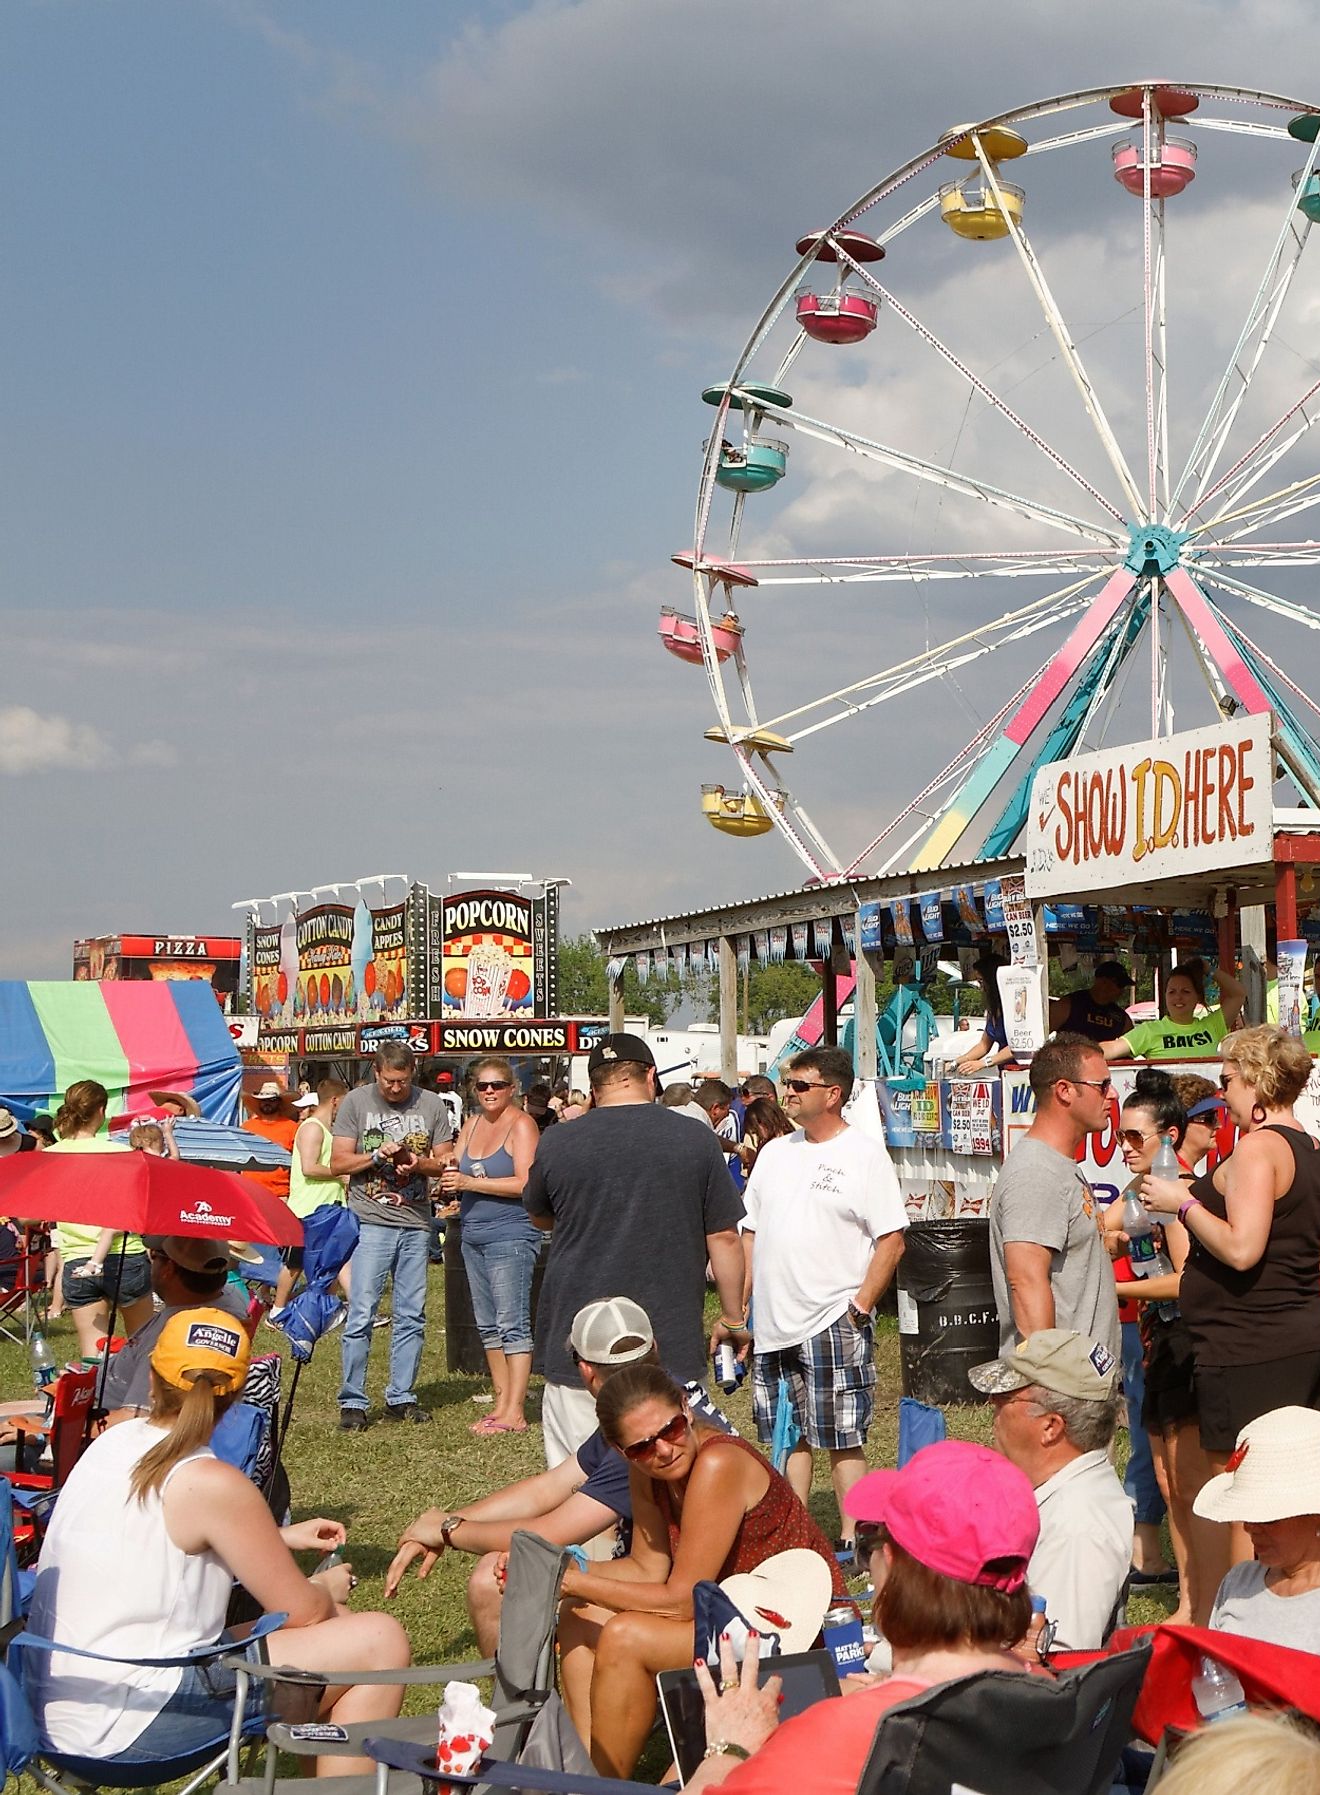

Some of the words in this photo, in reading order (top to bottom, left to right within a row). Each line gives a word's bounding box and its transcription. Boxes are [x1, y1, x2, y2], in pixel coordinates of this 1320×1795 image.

[1055, 764, 1126, 865] SHOW
[1132, 758, 1180, 862] I.D.
[1184, 739, 1255, 848] HERE
[374, 913, 403, 932] CANDY
[445, 899, 529, 935] POPCORN
[1005, 912, 1018, 921] CAN
[1018, 910, 1032, 920] BEER
[297, 914, 328, 948] COTTON
[328, 914, 353, 942] CANDY
[1008, 922, 1033, 938] $2.50
[155, 941, 207, 955] PIZZA
[256, 932, 280, 949] SNOW
[374, 932, 404, 949] APPLES
[256, 949, 280, 965] CONES
[431, 911, 441, 1002] FRESH
[535, 913, 544, 1002] SWEETS
[1087, 1013, 1113, 1027] LSU
[305, 1033, 334, 1051] COTTON
[334, 1031, 356, 1050] CANDY
[444, 1028, 500, 1048] SNOW
[503, 1027, 566, 1047] CONES
[1013, 1029, 1032, 1037] Beer
[360, 1038, 429, 1053] DRKS
[972, 1137, 990, 1150] 1994
[180, 1210, 232, 1226] Academy
[192, 1327, 237, 1347] Angelle
[835, 1646, 865, 1662] PARK
